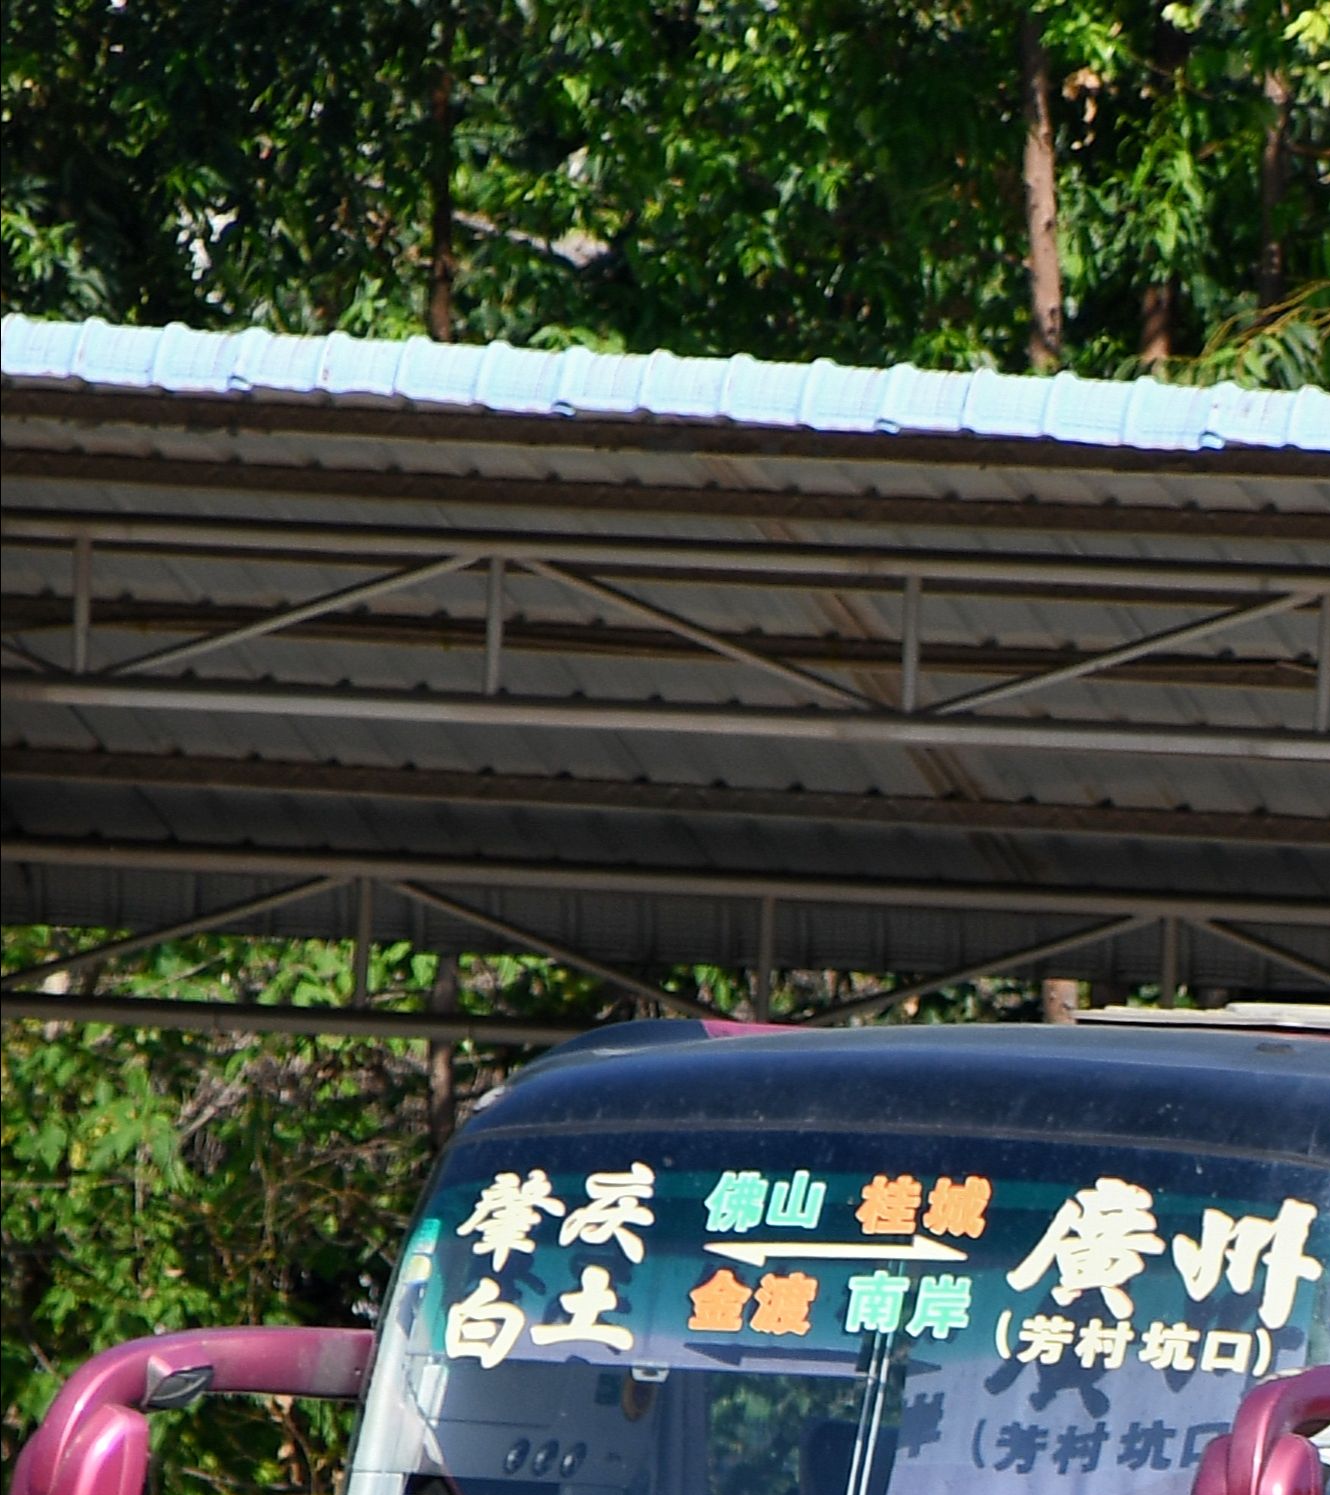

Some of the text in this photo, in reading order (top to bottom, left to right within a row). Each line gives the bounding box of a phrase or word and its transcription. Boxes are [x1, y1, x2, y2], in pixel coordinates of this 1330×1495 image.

[704, 1170, 991, 1238] 佛山 桂城
[445, 1265, 633, 1368] 白土
[688, 1268, 972, 1339] 金渡 南岸
[995, 1310, 1271, 1377] (芳村坑口)
